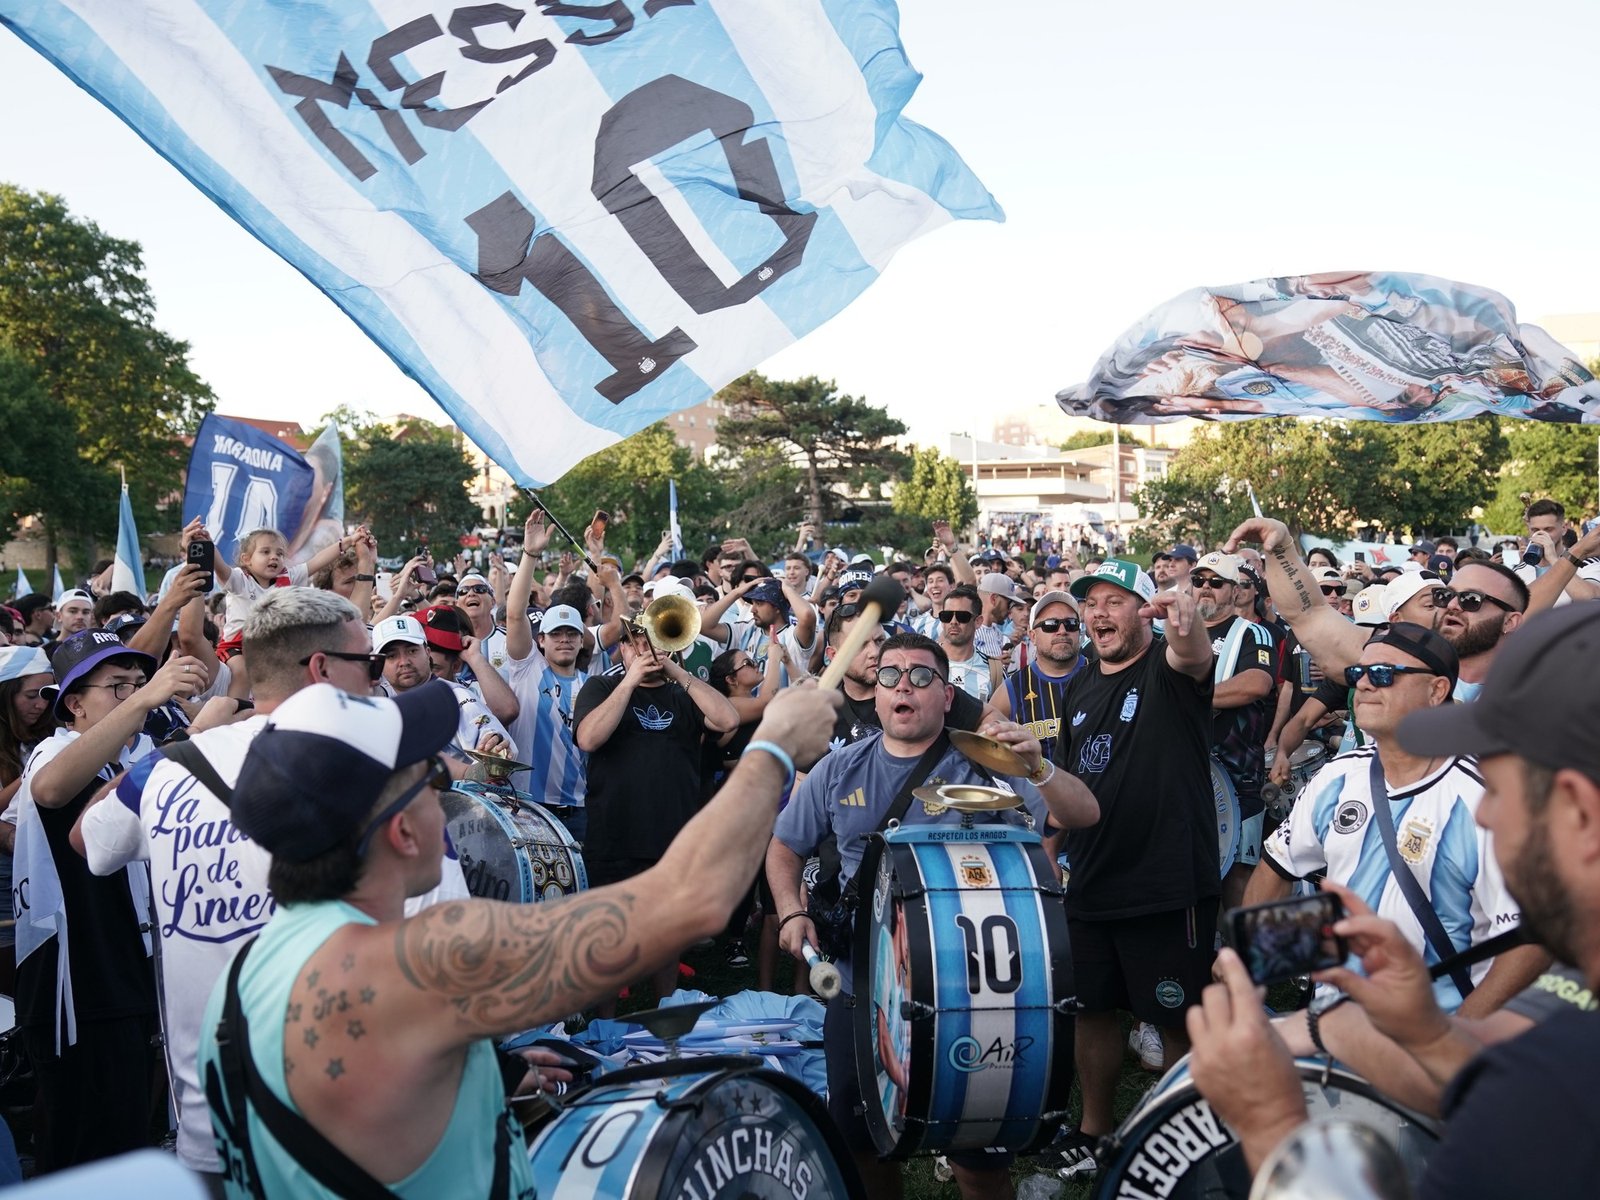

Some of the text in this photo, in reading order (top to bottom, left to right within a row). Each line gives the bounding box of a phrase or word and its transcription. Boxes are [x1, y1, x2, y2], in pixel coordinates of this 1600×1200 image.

[264, 0, 696, 181] MESS
[464, 74, 818, 405] 10
[213, 434, 284, 472] MARAONA
[151, 775, 201, 839] La
[927, 830, 1007, 841] RESPETEN LOS RANGOS
[172, 818, 250, 871] pan
[207, 848, 239, 883] de
[967, 867, 986, 881] AFA
[954, 914, 1024, 995] 10
[558, 1110, 644, 1172] 10
